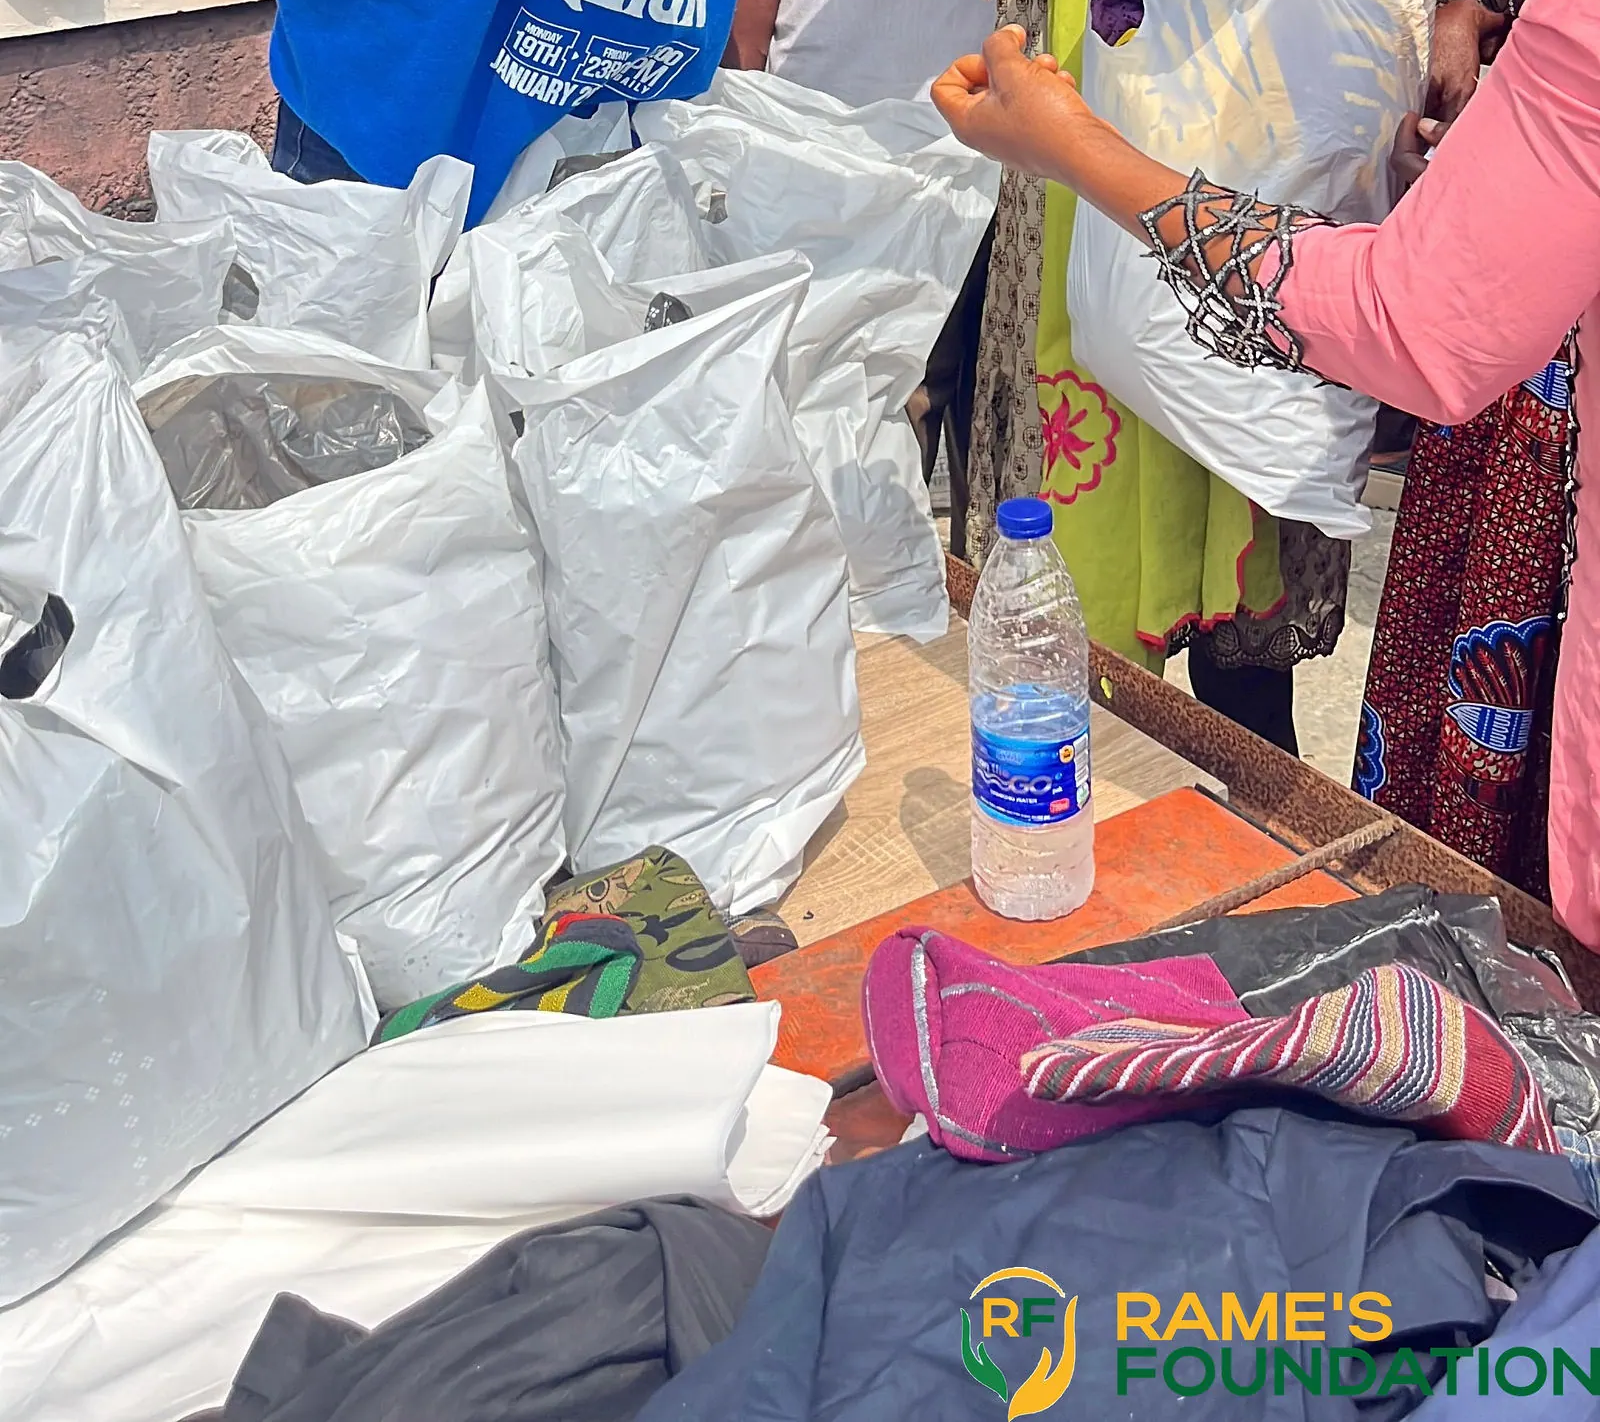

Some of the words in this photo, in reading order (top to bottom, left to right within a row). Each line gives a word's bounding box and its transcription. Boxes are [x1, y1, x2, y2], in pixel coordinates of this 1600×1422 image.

[524, 21, 563, 45] MONDAY
[511, 30, 563, 69] 19TH
[602, 47, 633, 62] FRIDAY
[490, 48, 579, 108] JANUARY
[613, 73, 650, 95] DAILY
[1009, 774, 1053, 795] GO
